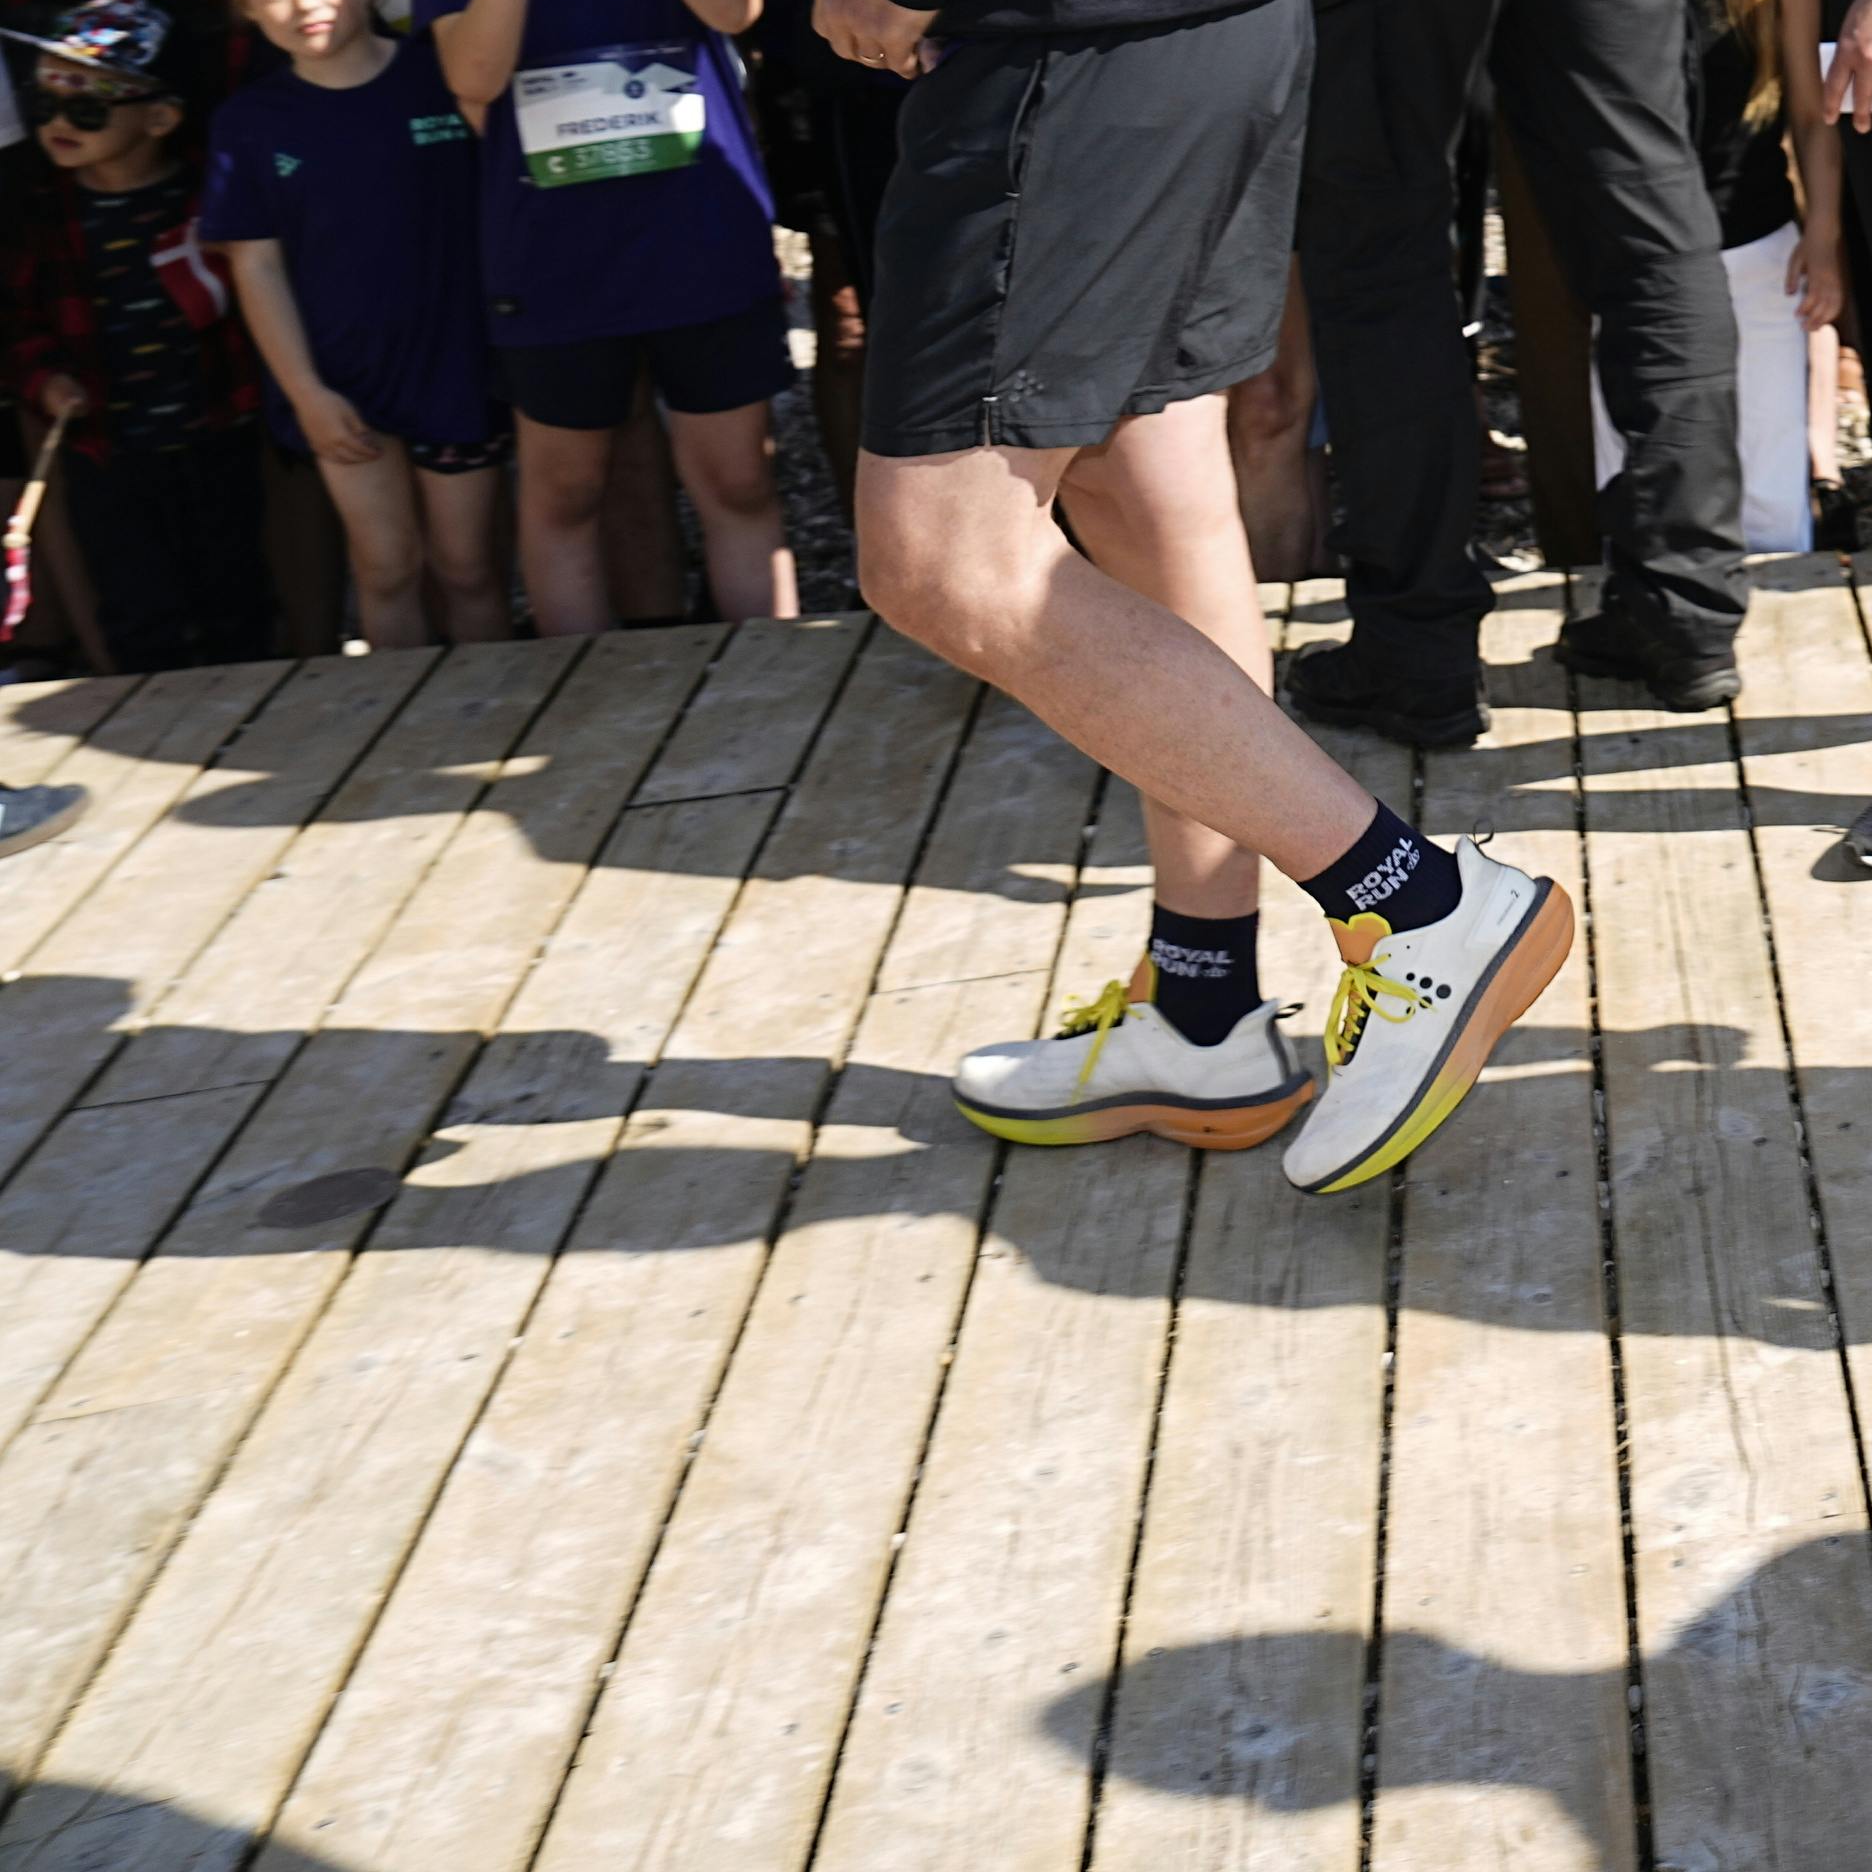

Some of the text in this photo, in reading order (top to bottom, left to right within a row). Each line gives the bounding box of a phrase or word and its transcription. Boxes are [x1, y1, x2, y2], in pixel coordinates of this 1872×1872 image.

[1346, 836, 1413, 902] ROYAL
[1354, 866, 1409, 912] RUN
[1153, 938, 1236, 964] ROYAL
